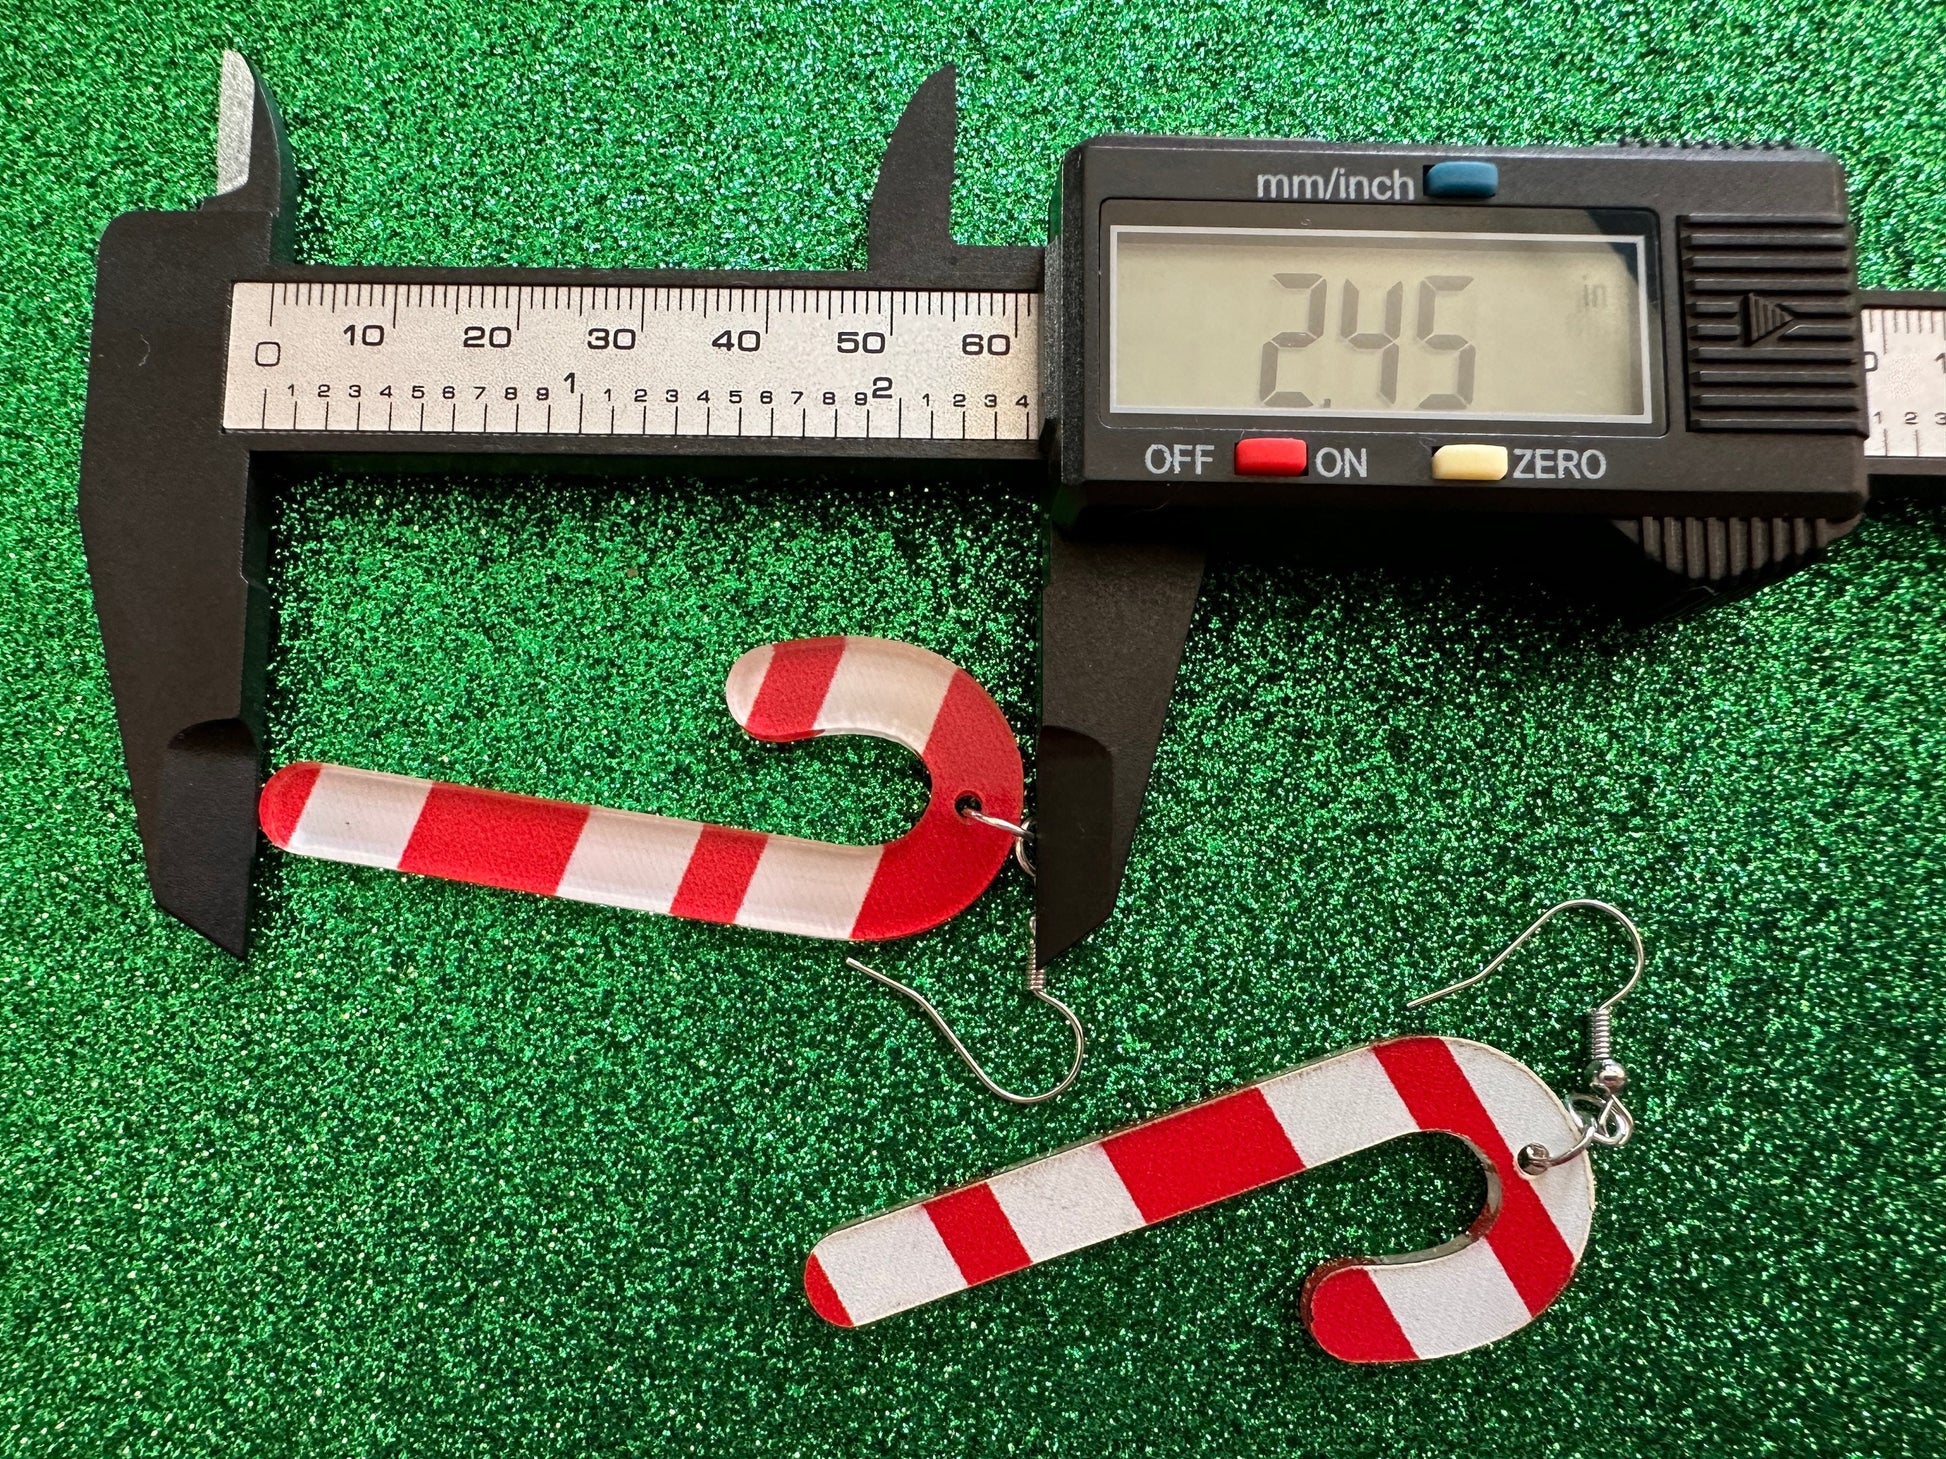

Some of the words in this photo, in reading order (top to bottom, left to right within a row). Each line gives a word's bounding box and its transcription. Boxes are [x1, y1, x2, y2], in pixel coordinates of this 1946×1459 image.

[1256, 167, 1415, 201] mm/inch
[254, 341, 282, 368] 0
[343, 324, 385, 347] 10
[462, 325, 512, 349] 20
[586, 327, 637, 351] 30
[711, 329, 761, 353] 40
[836, 331, 886, 354] 50
[961, 333, 1011, 357] 60
[317, 383, 331, 398] 2
[348, 384, 362, 399] 3
[379, 384, 393, 399] 4
[411, 385, 426, 400] 5
[442, 385, 456, 400] 6
[473, 386, 487, 401] 7
[503, 386, 518, 401] 8
[535, 386, 550, 402] 9
[563, 372, 576, 394] 1
[633, 388, 648, 403] 2
[665, 388, 679, 404] 3
[696, 389, 711, 404] 4
[728, 390, 743, 404] 5
[759, 390, 773, 405] 6
[790, 390, 804, 405] 7
[822, 391, 836, 406] 8
[854, 391, 868, 406] 9
[871, 376, 893, 399] 2
[952, 393, 967, 408] 2
[984, 393, 998, 409] 3
[1015, 394, 1030, 409] 4
[1904, 411, 1918, 426] 2
[1144, 443, 1215, 475] OFF
[1315, 446, 1368, 478] ON
[1512, 448, 1607, 480] ZERO
